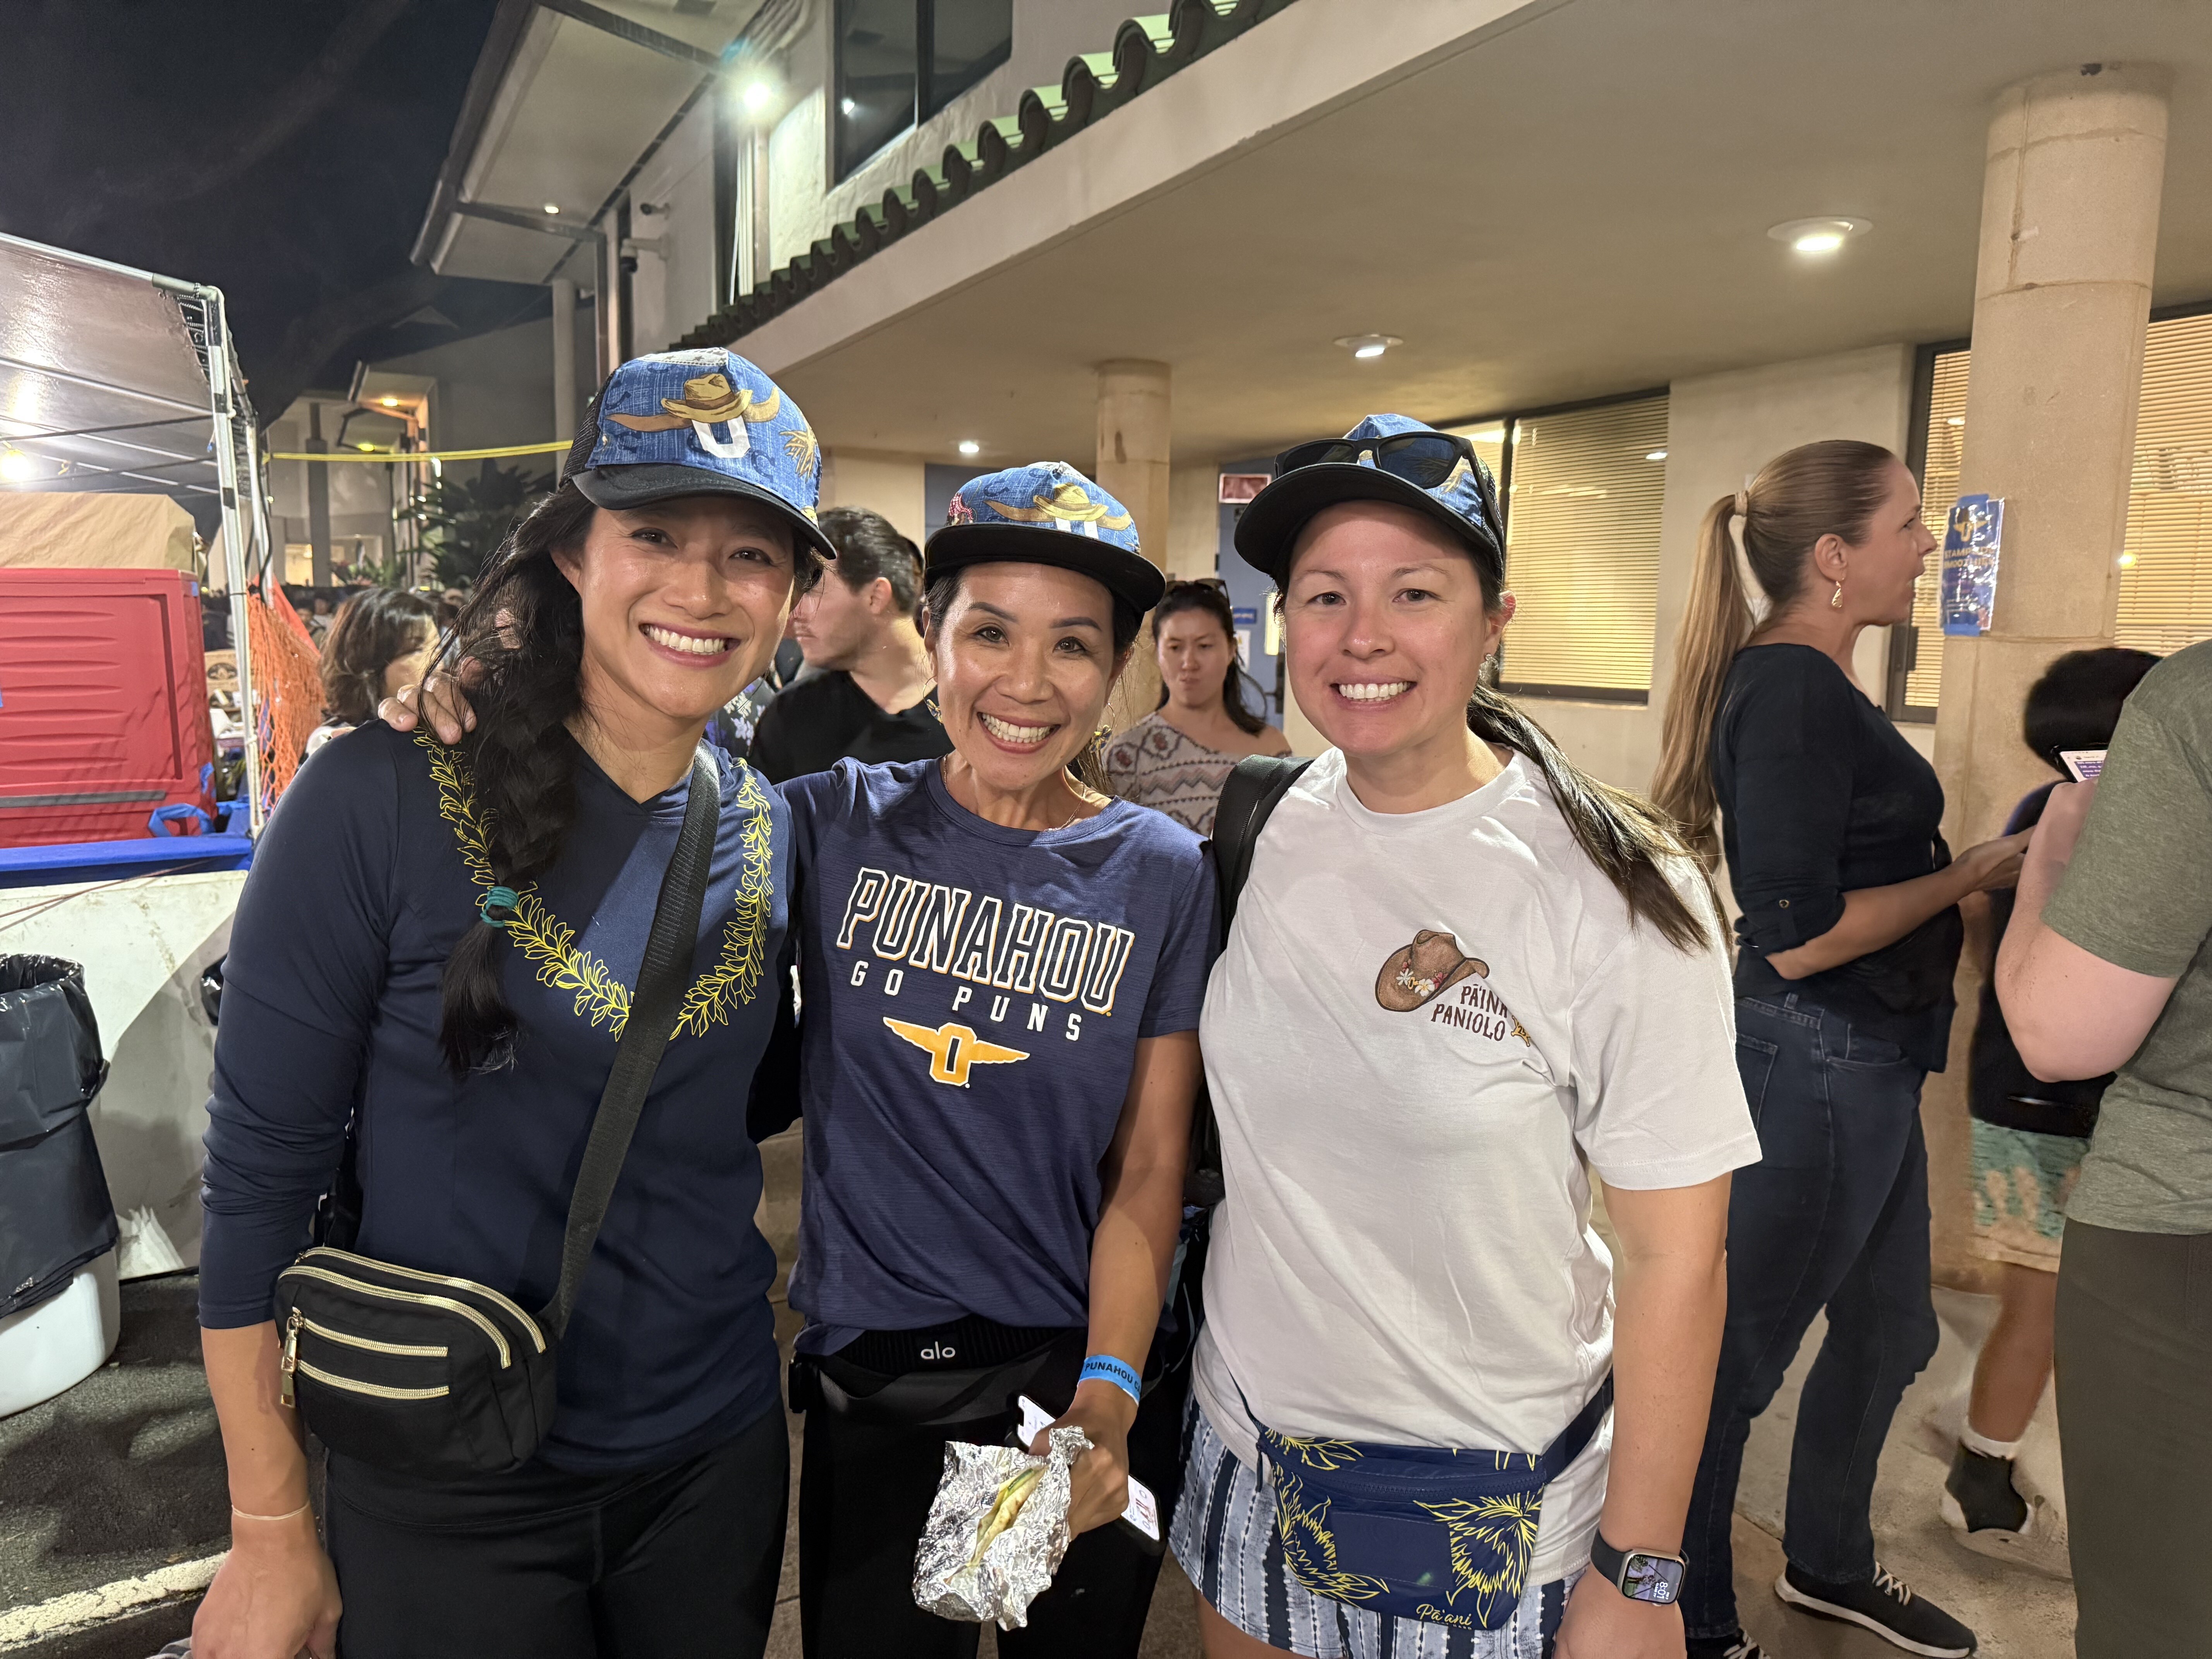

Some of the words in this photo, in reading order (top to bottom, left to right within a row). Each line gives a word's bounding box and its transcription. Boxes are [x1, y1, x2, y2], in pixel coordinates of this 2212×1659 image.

[836, 867, 1135, 1015] PUNAHOU
[850, 960, 904, 996] GO
[951, 986, 1082, 1042] PUNS
[1431, 1003, 1506, 1041] PANIOLO
[921, 1341, 956, 1360] alo
[1085, 1361, 1133, 1384] PUNAHOU
[1657, 1582, 1668, 1599] 8:01
